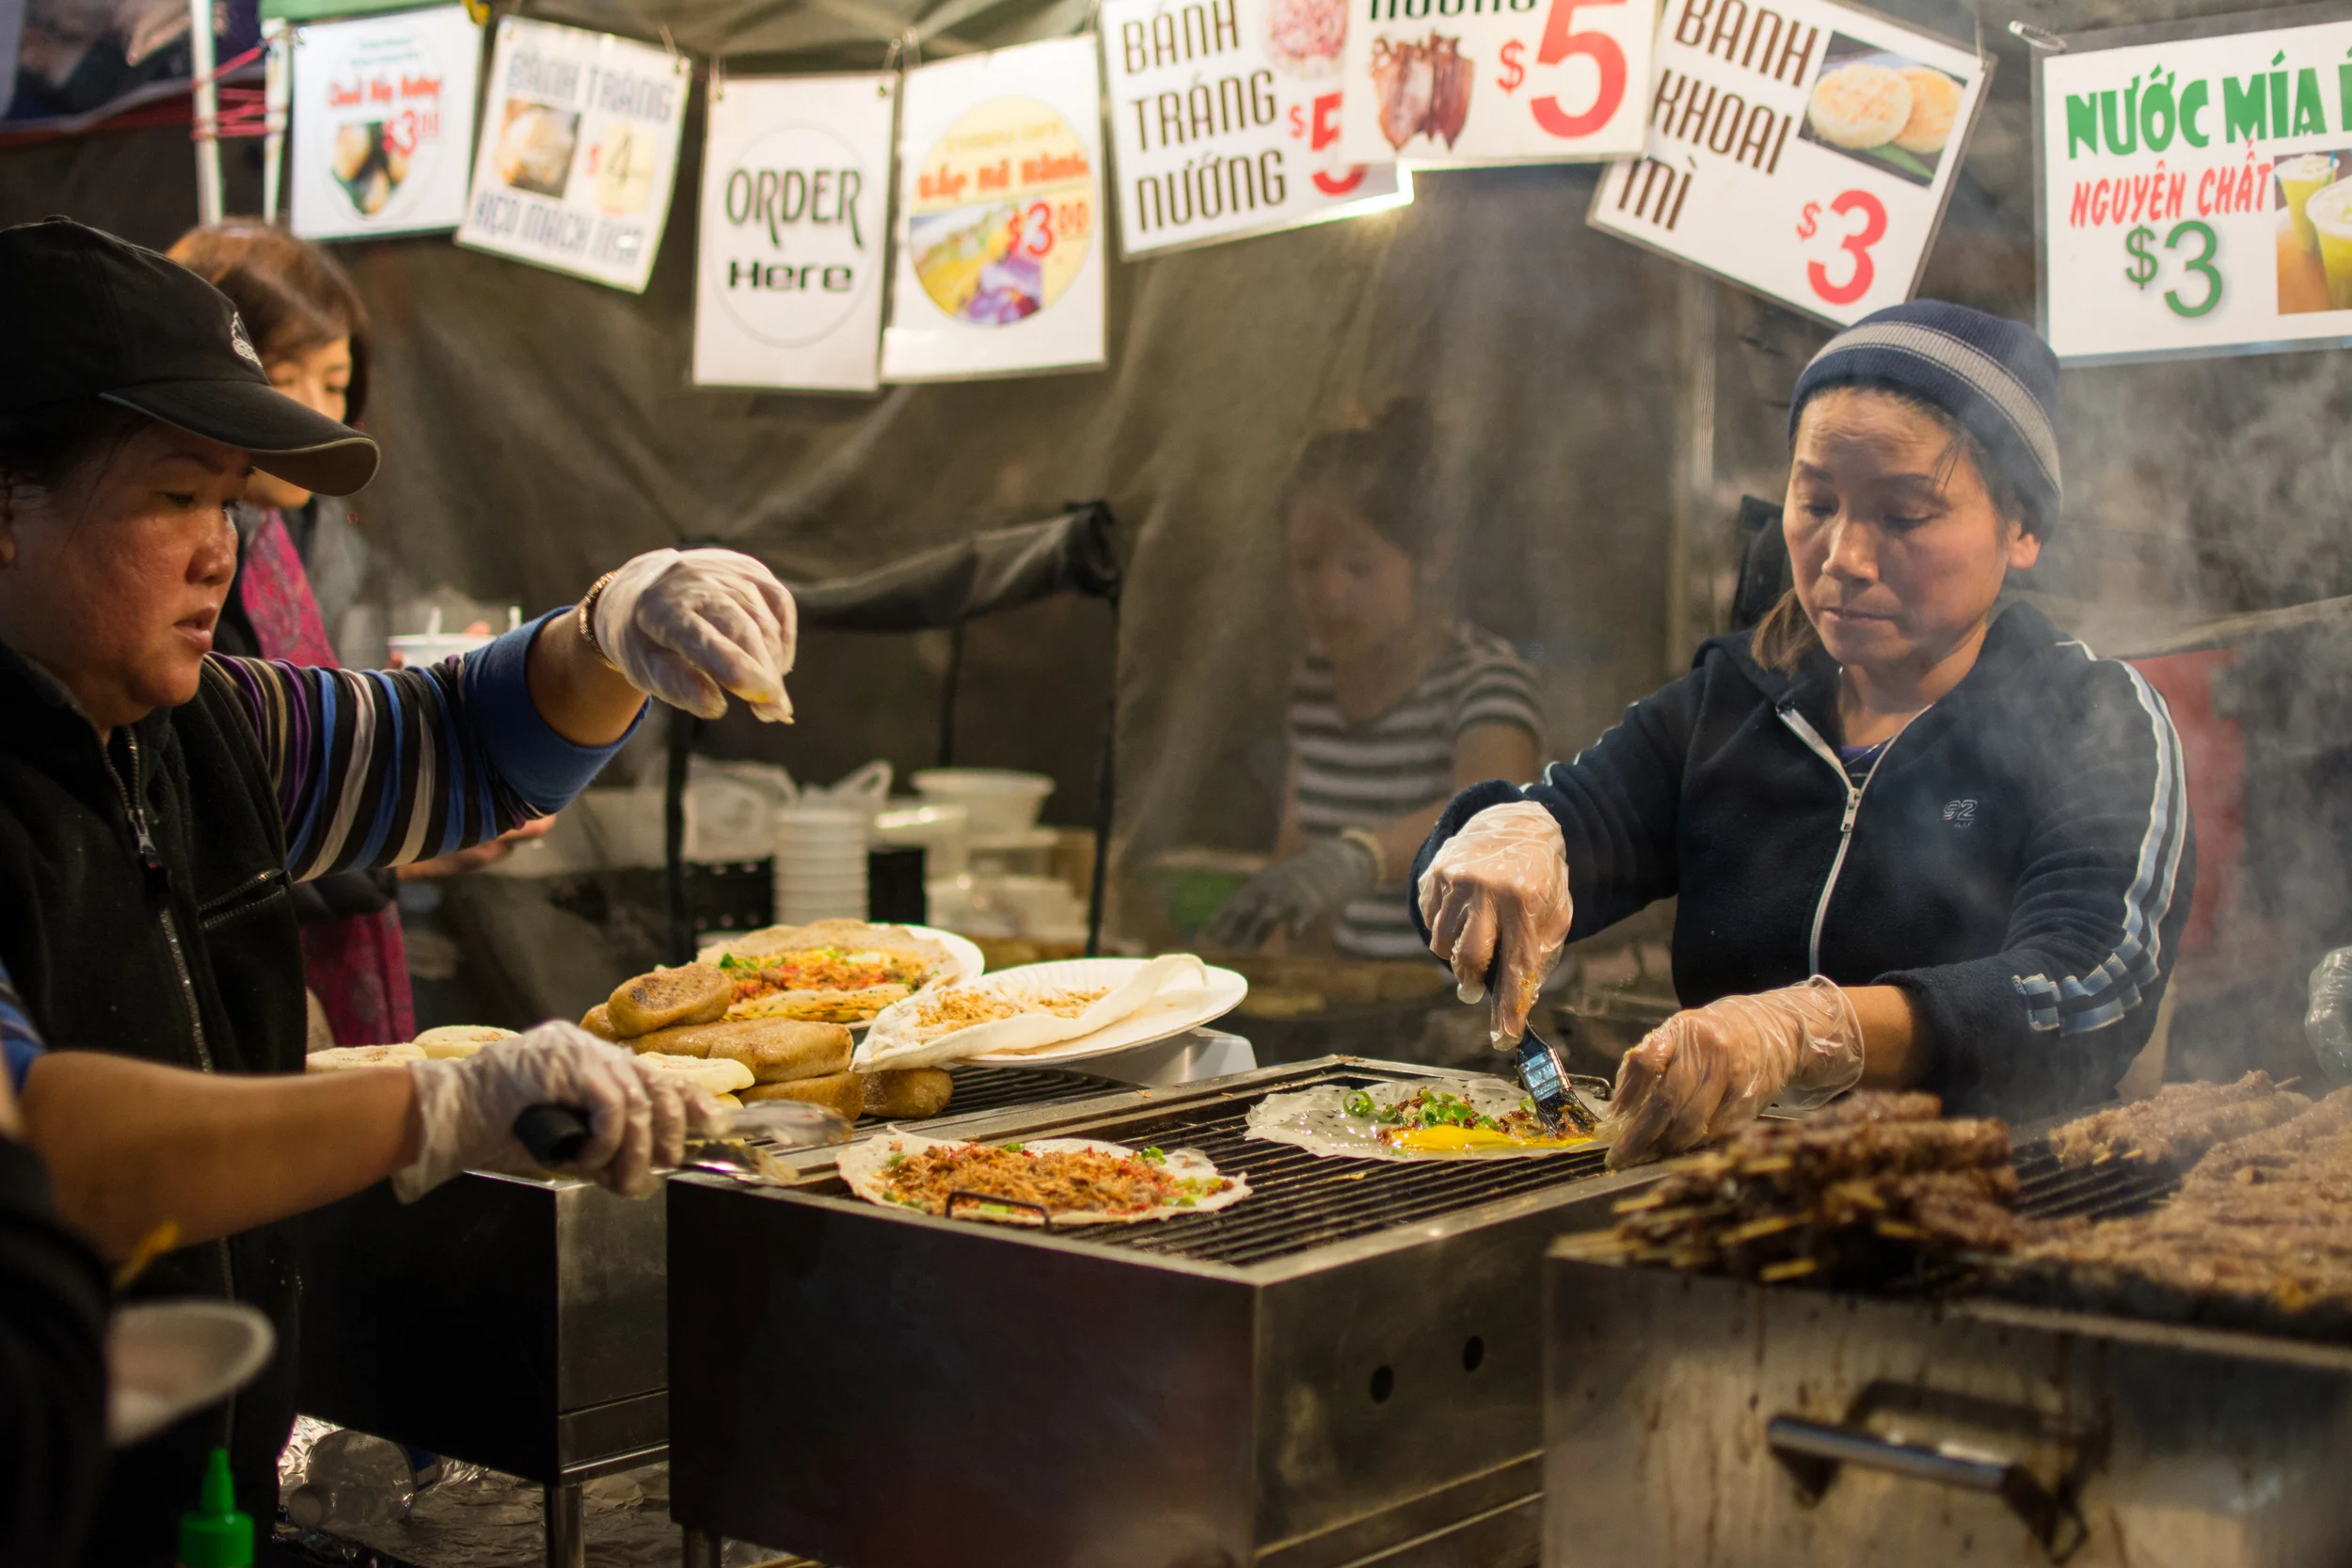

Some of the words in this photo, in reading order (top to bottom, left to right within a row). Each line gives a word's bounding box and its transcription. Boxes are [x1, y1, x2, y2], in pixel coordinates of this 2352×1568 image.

[1129, 71, 1277, 151] TRÁNG
[1497, 0, 1628, 138] $5
[2066, 63, 2210, 159] NƯỚC
[2222, 49, 2328, 144] MÍA
[1654, 69, 1793, 176] KHOAI
[725, 168, 863, 249] ORDER
[1136, 149, 1286, 232] NƯỚNG
[1617, 155, 1697, 232] MÌ
[2070, 159, 2186, 228] NGUYÊN
[2198, 138, 2272, 217] CHẤT
[728, 261, 852, 291] Here
[1795, 188, 1888, 306] $3
[2124, 220, 2223, 318] $3
